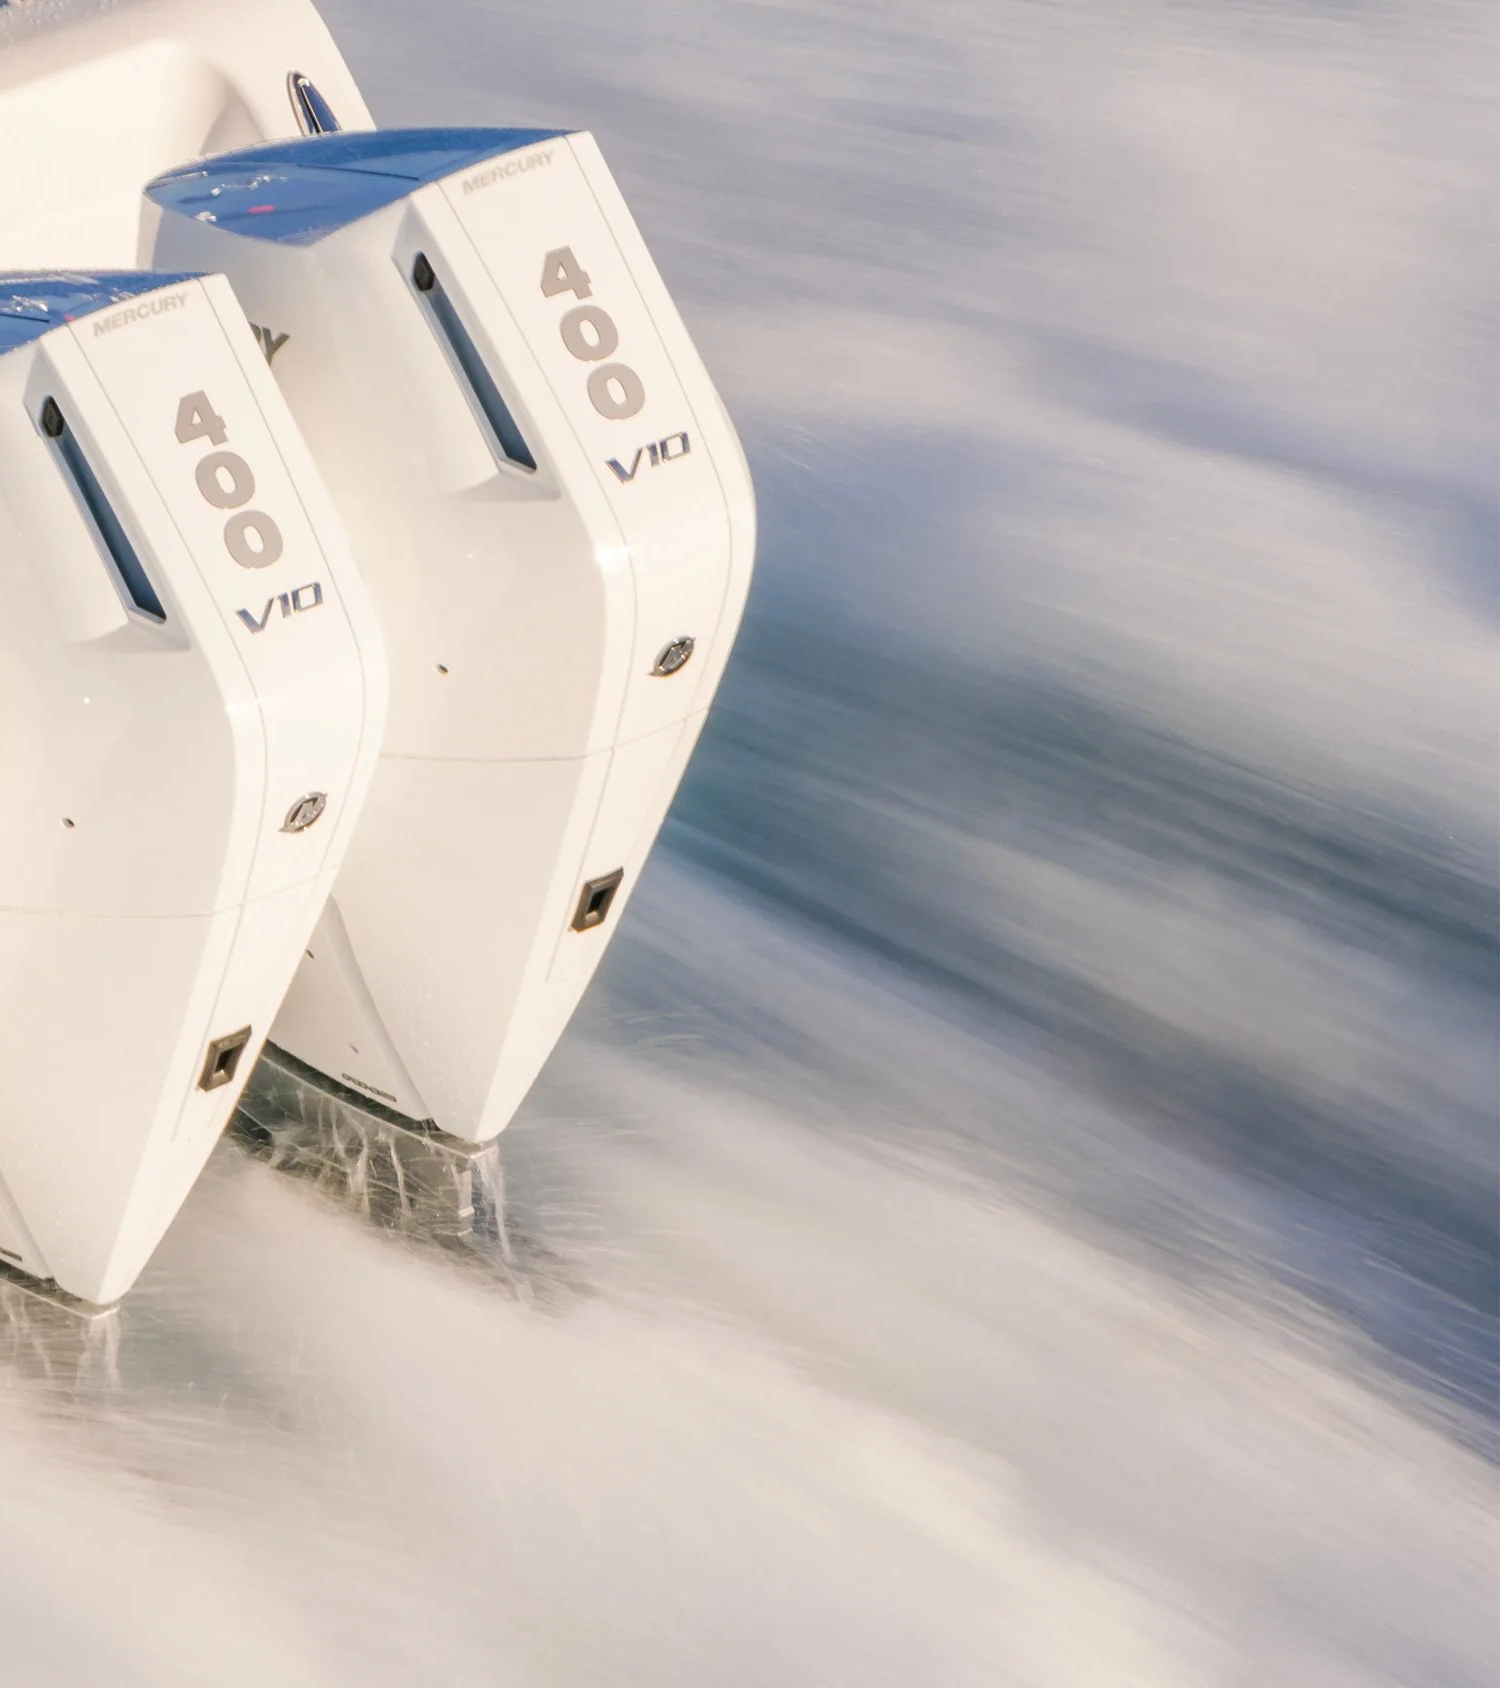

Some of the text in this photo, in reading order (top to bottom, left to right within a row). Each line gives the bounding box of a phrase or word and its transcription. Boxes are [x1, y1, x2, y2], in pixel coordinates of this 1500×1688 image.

[462, 149, 554, 196] MERCURY
[93, 293, 188, 338] MERCURY
[540, 246, 646, 421] 400
[175, 391, 284, 569] 400
[605, 432, 692, 484] V10
[236, 583, 324, 634] V10
